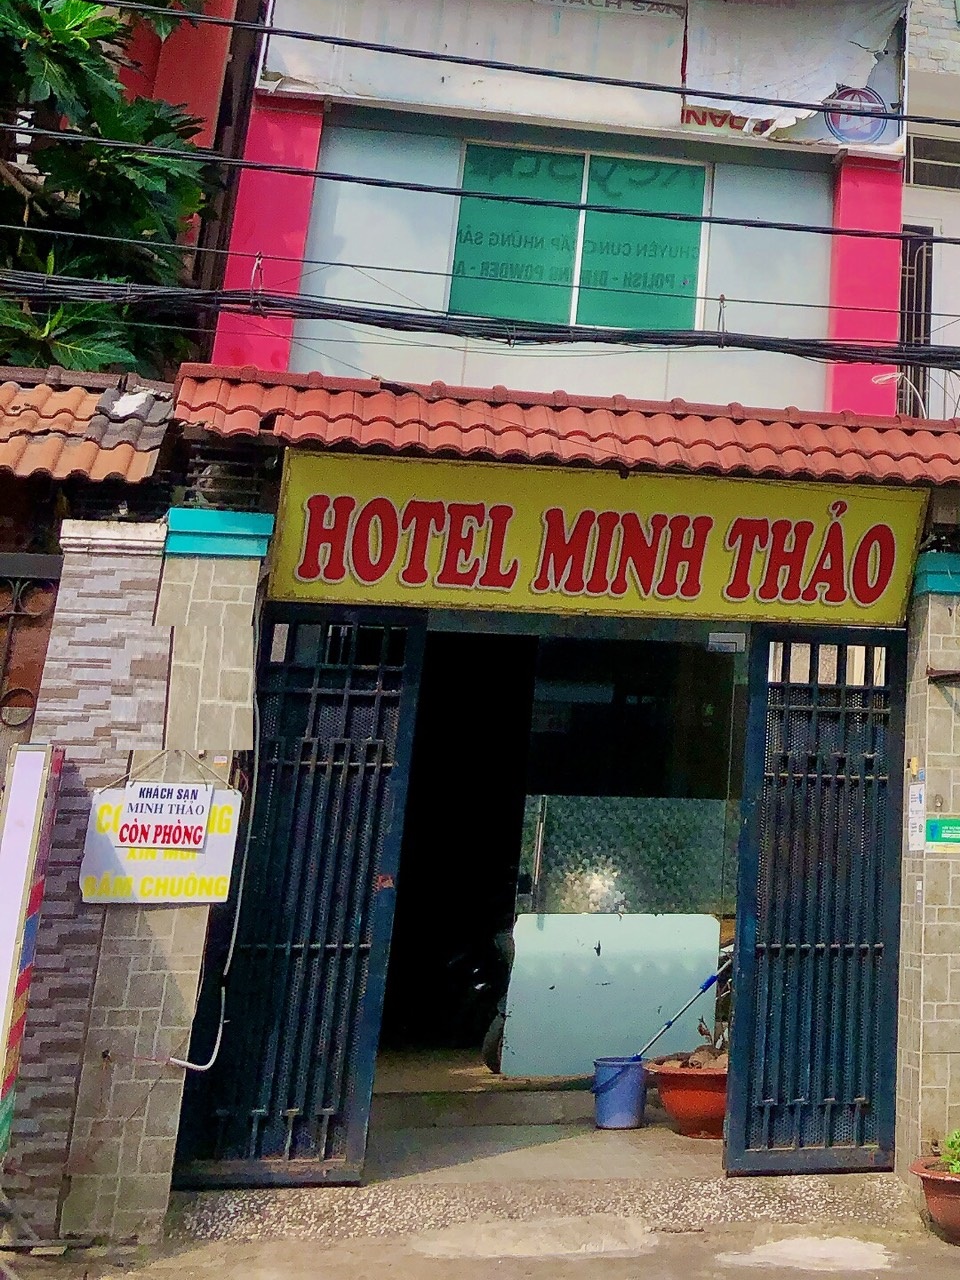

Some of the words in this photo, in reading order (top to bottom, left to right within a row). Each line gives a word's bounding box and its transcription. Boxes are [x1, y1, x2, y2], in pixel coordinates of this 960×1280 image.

[295, 494, 520, 591] HOTEL
[532, 506, 714, 599] MINH
[724, 500, 897, 608] THẢO
[139, 784, 173, 800] KHÁCH
[176, 788, 198, 803] SẠN
[127, 802, 163, 815] MINH
[168, 800, 205, 816] THẢO
[118, 818, 151, 844] CÒN
[152, 819, 203, 846] PHÒNG
[140, 872, 229, 898] CHUÔNG
